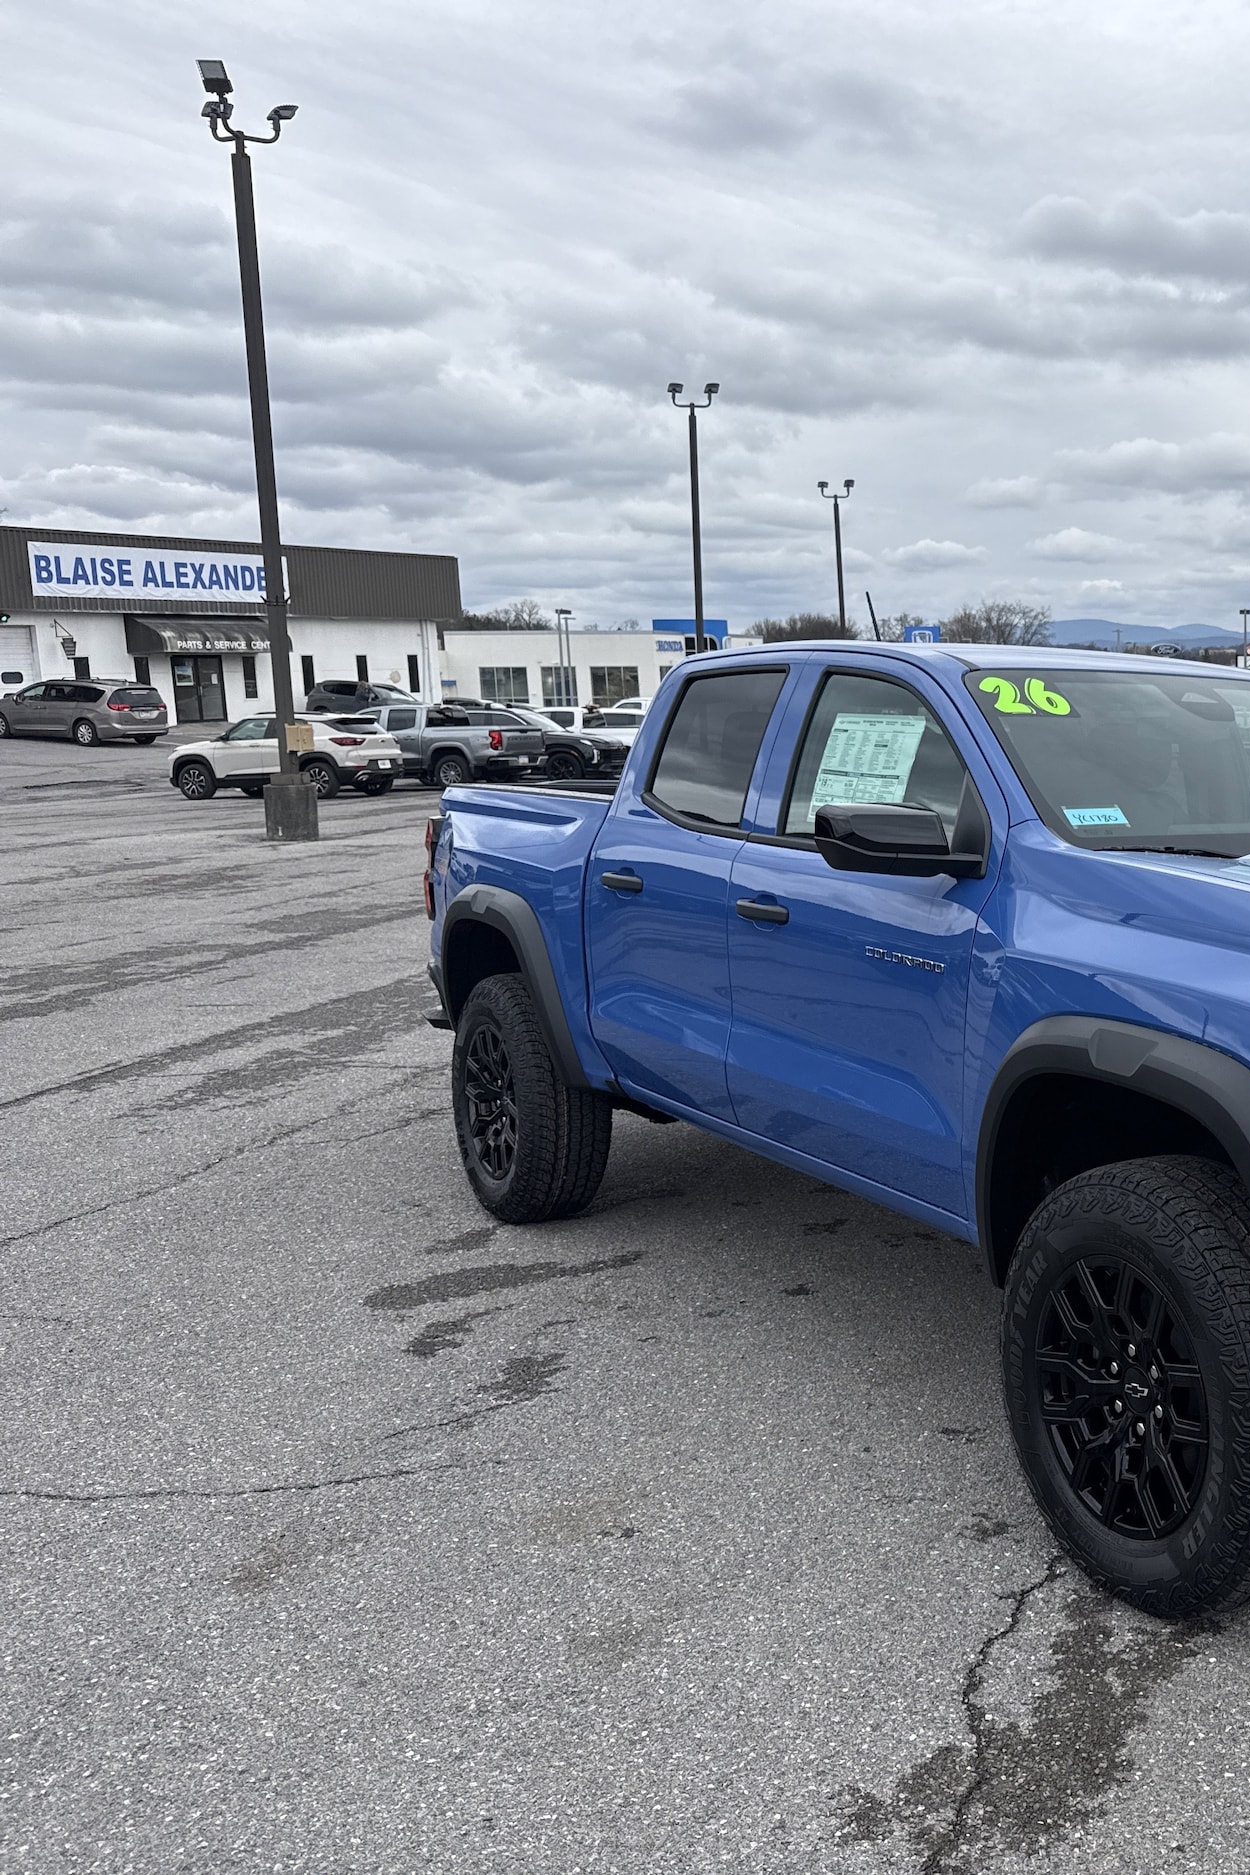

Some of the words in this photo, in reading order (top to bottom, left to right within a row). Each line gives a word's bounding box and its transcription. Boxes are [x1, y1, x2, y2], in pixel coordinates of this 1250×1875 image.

[34, 554, 134, 587] BLAISE
[142, 560, 267, 592] ALEXANDE
[177, 640, 203, 649] PARTS
[205, 640, 212, 649] &
[214, 640, 247, 649] SERVICE
[656, 640, 684, 651] HONDA
[979, 676, 1071, 715] 26
[865, 945, 945, 973] COLORADO
